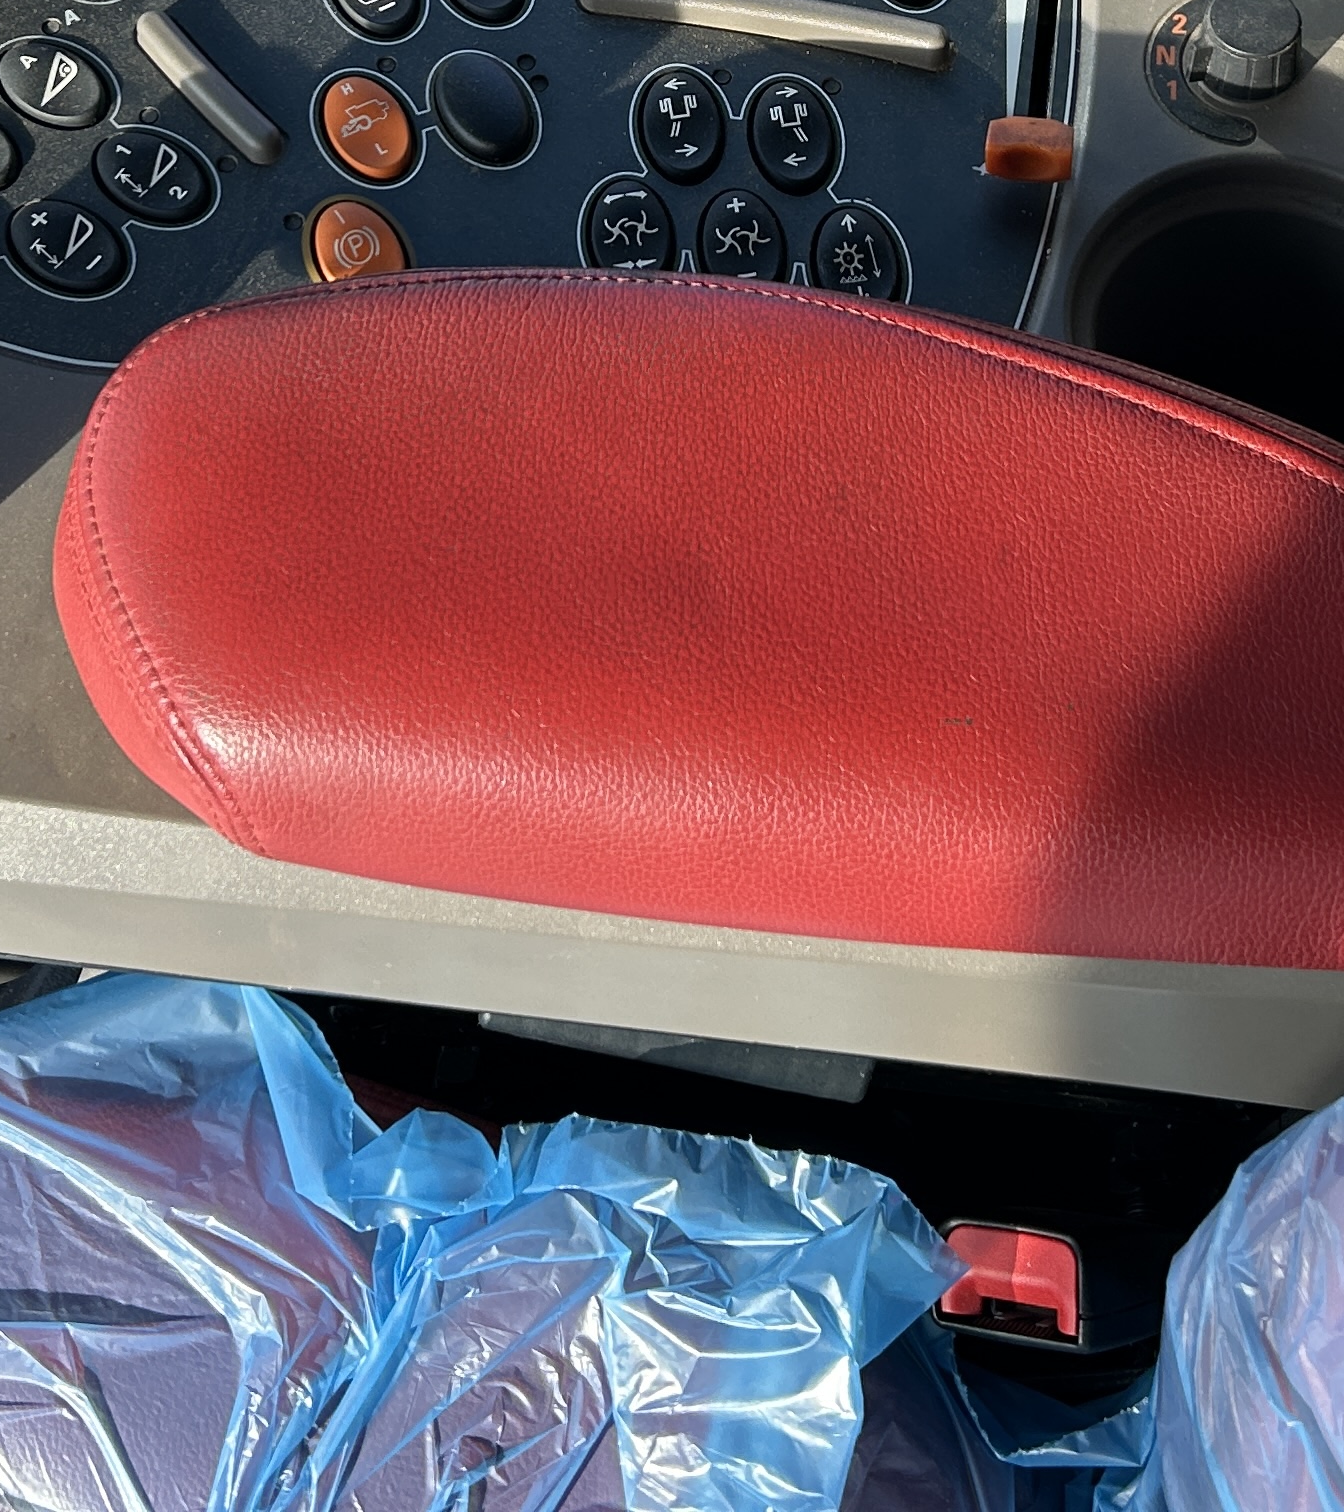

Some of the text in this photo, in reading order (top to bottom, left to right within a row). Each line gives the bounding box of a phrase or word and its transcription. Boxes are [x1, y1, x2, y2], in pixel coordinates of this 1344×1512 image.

[65, 9, 81, 26] A
[1171, 13, 1187, 35] 2
[20, 55, 38, 69] A
[1156, 45, 1175, 65] N
[340, 82, 354, 96] H
[1167, 80, 1177, 100] 1
[116, 144, 132, 155] 1
[375, 143, 388, 155] L
[169, 186, 189, 200] 2
[348, 235, 363, 258] P
